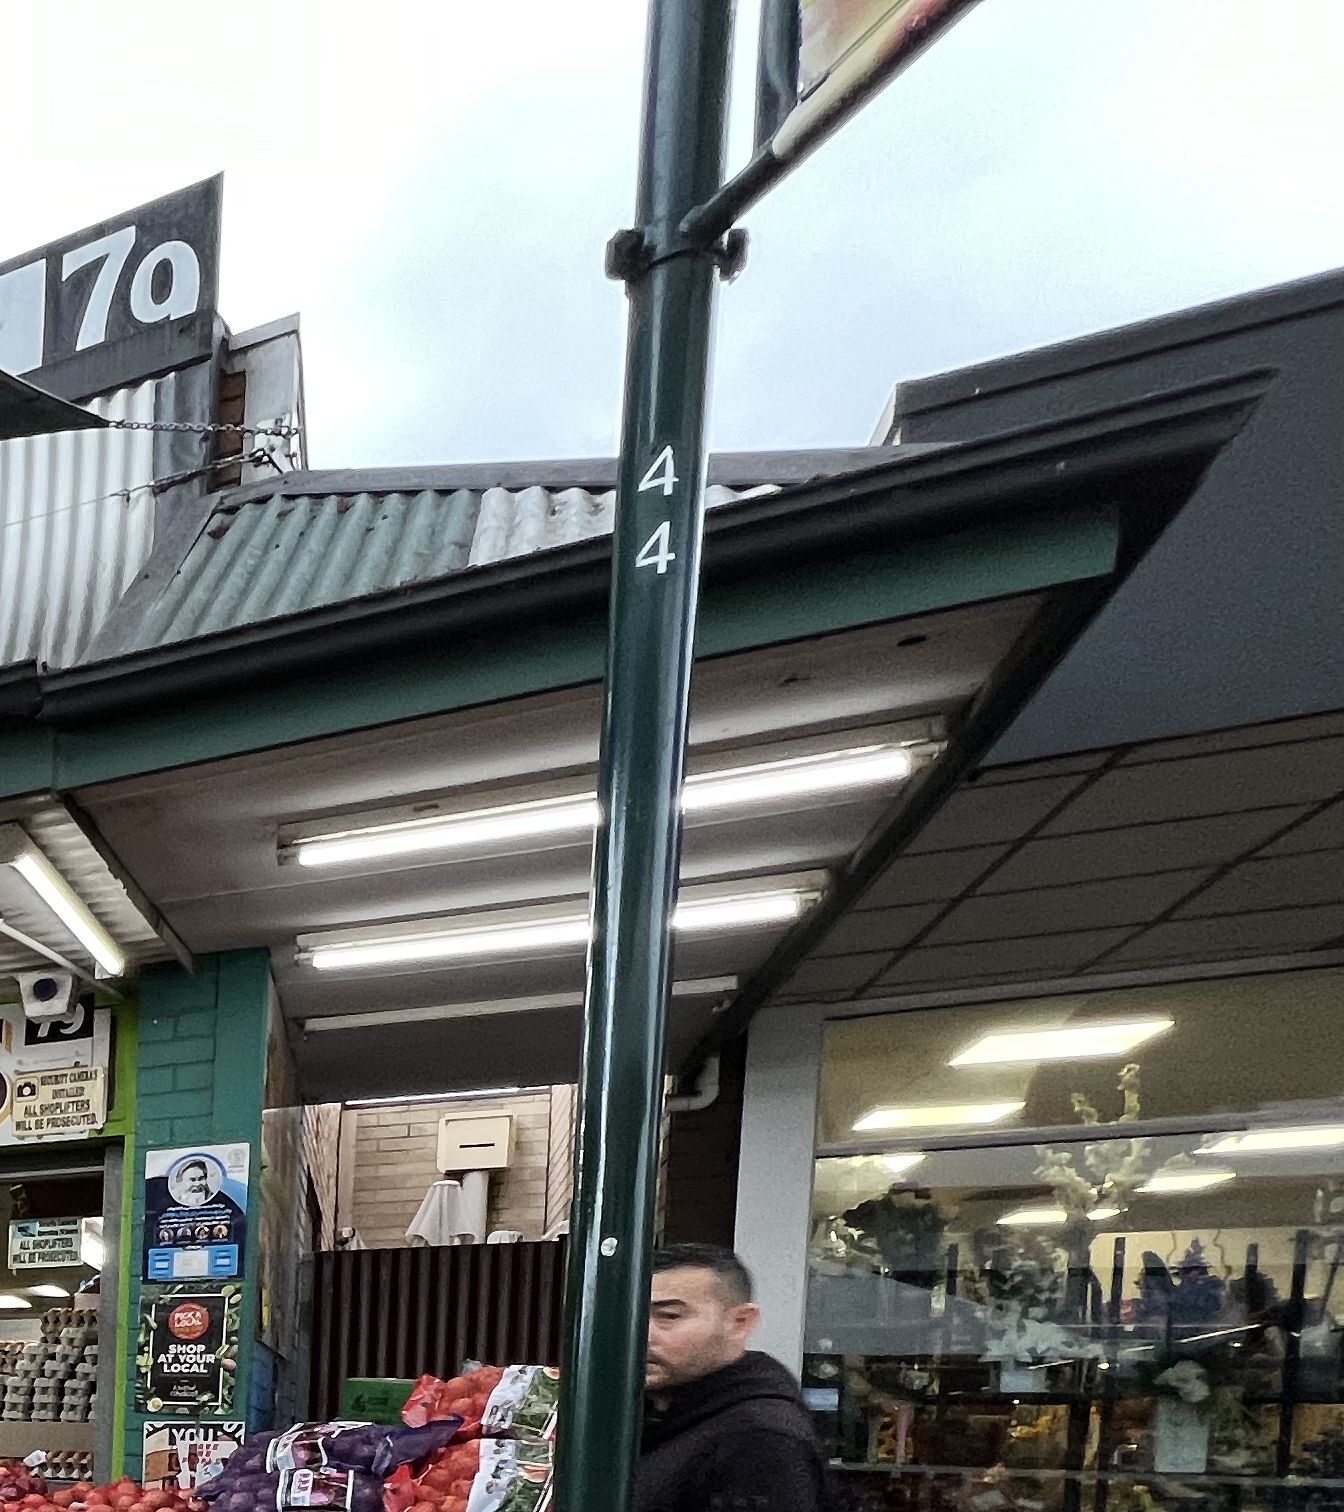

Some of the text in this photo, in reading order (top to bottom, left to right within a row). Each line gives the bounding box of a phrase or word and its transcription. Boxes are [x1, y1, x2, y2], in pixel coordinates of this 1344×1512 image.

[24, 1099, 90, 1117] ALL SHOPLIFTERS
[15, 1120, 32, 1131] WILL
[35, 1118, 44, 1130] BE
[168, 1344, 206, 1354] SHOP
[157, 1354, 215, 1364] AT YOUR
[163, 1363, 208, 1373] LOCAL
